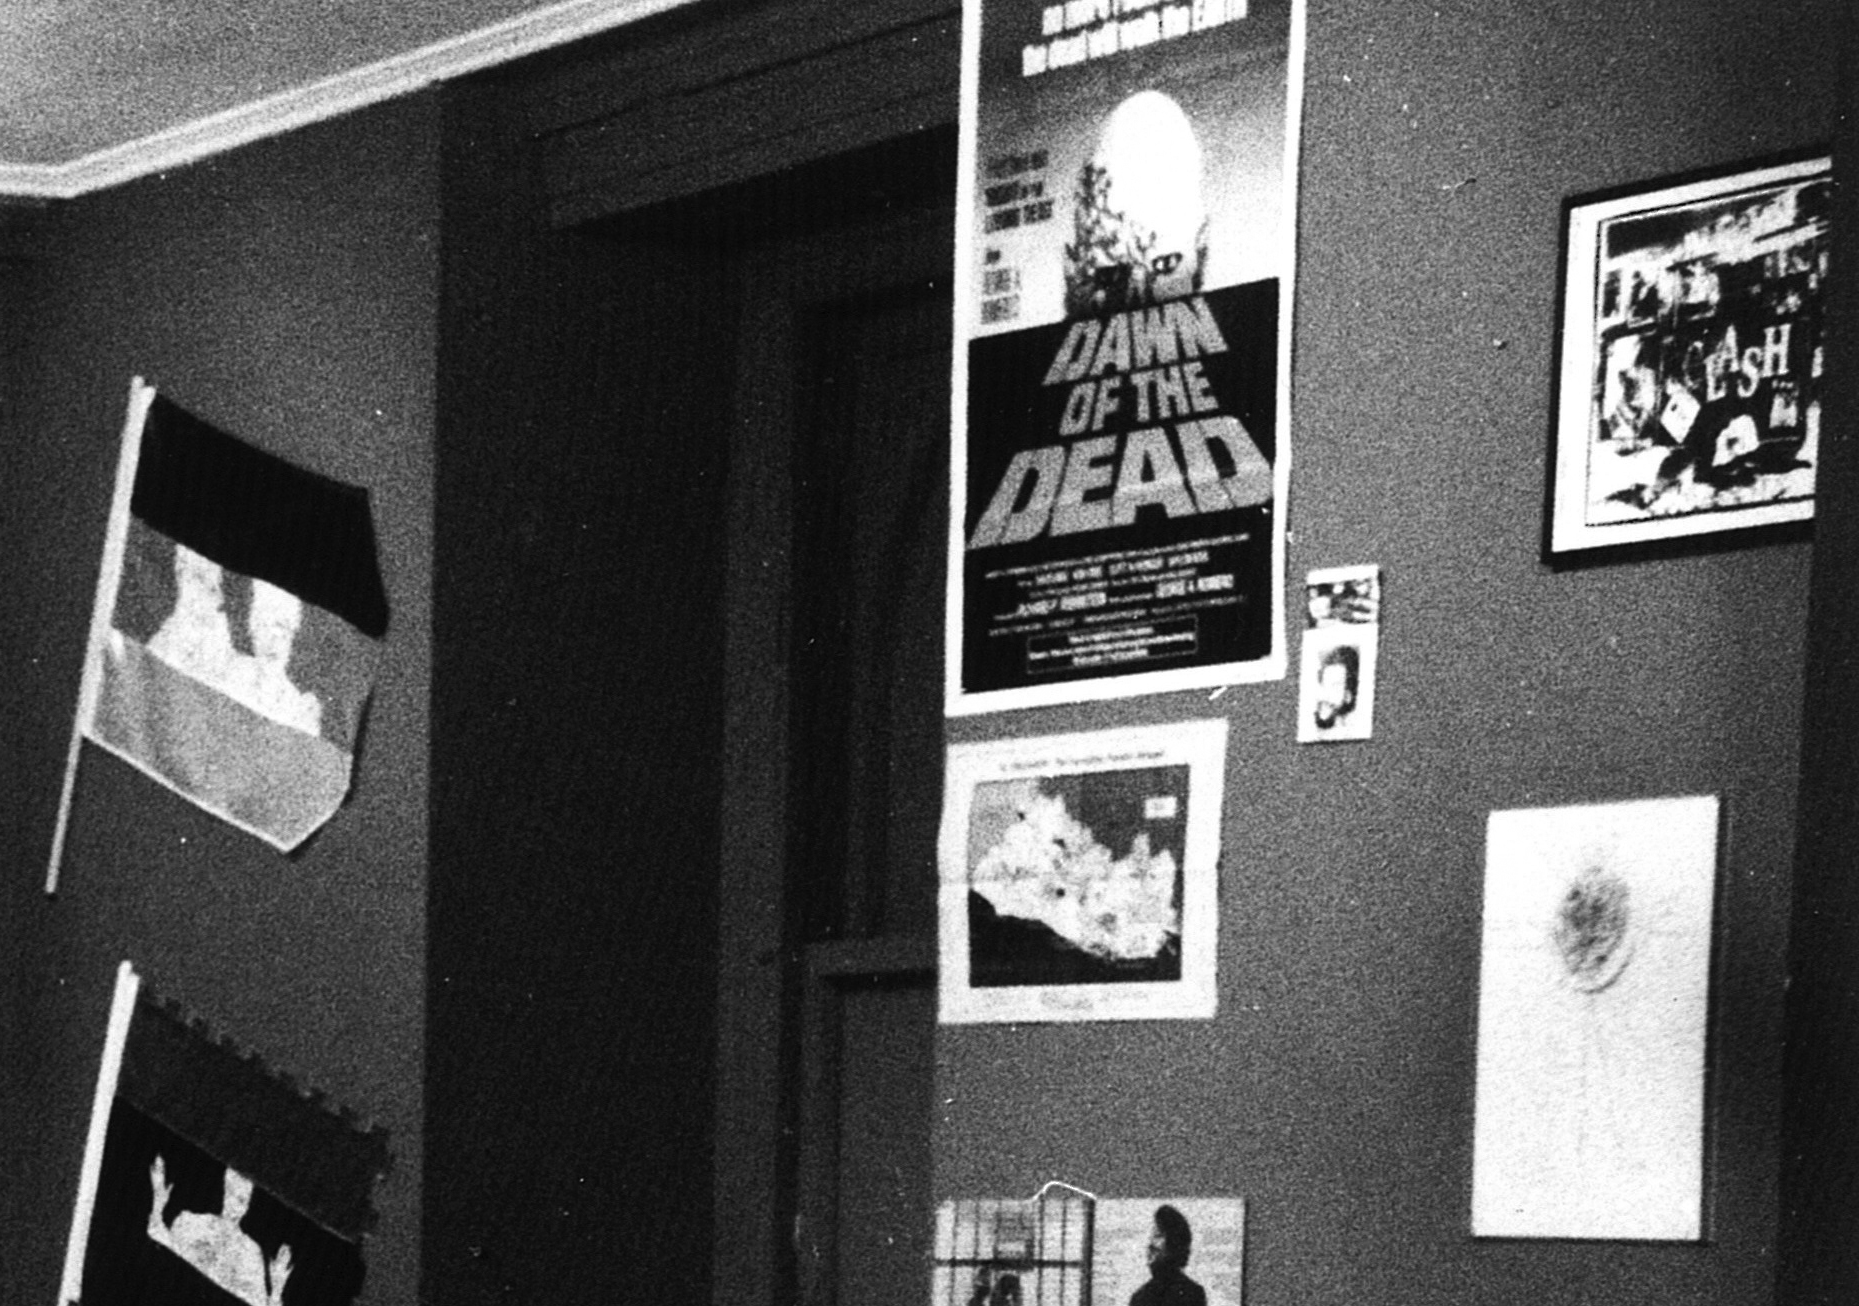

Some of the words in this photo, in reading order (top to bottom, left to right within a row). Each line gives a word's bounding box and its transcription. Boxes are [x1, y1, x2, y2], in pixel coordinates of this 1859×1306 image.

[1043, 296, 1229, 388] DAWN
[1682, 323, 1792, 402] CLASH
[1058, 372, 1121, 437] OF
[1135, 357, 1220, 421] THE
[968, 415, 1274, 551] DEAD
